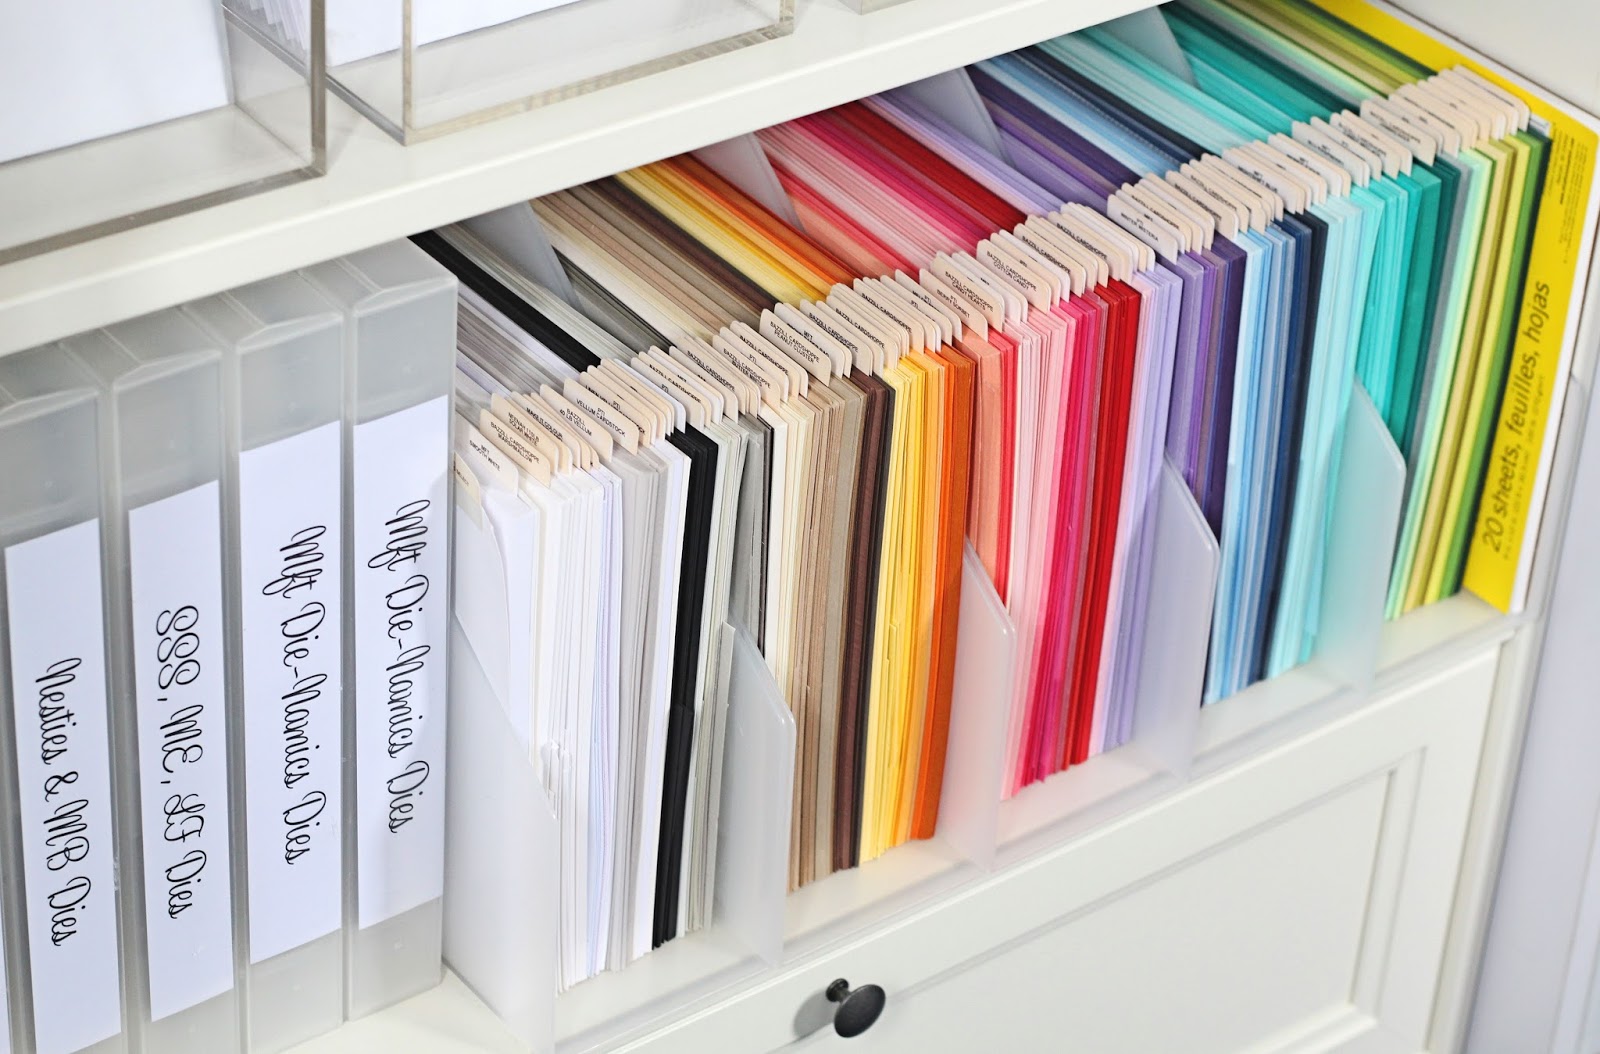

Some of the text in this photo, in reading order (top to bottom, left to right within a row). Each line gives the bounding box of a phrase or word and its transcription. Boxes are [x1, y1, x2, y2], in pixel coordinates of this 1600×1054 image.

[944, 271, 961, 287] BAZZILL
[963, 284, 993, 312] CARDSHOPPE
[986, 250, 1036, 291] BAZZILL CARDSHOPPE
[1522, 280, 1551, 344] hojas
[770, 321, 820, 363] BAZZILL CARDSHOPPE
[774, 329, 814, 364] PEANUT CLUSTER
[1505, 350, 1541, 435] feuilles,
[509, 418, 523, 434] SOLAR
[524, 431, 538, 446] WHITE
[566, 407, 585, 426] BAZZILL
[573, 419, 591, 436] VELLUM
[576, 398, 595, 415] VELLUM
[596, 412, 625, 437] CARDSTOCK
[488, 457, 500, 471] WHITE
[490, 421, 507, 438] BAZZILL
[509, 436, 539, 464] CARDSHOPPE
[498, 432, 532, 463] MARSHMALLOW
[1492, 442, 1522, 517] sheets,
[1482, 515, 1505, 553] 20
[156, 605, 201, 702] SSS,
[385, 574, 431, 759] Die-Namics
[280, 601, 328, 789] Die-Namics
[159, 704, 204, 784] ME,
[35, 657, 92, 947] Nesties & MB Dies
[386, 760, 430, 834] Dies
[282, 790, 327, 865] Dies
[164, 849, 207, 920] Dies
